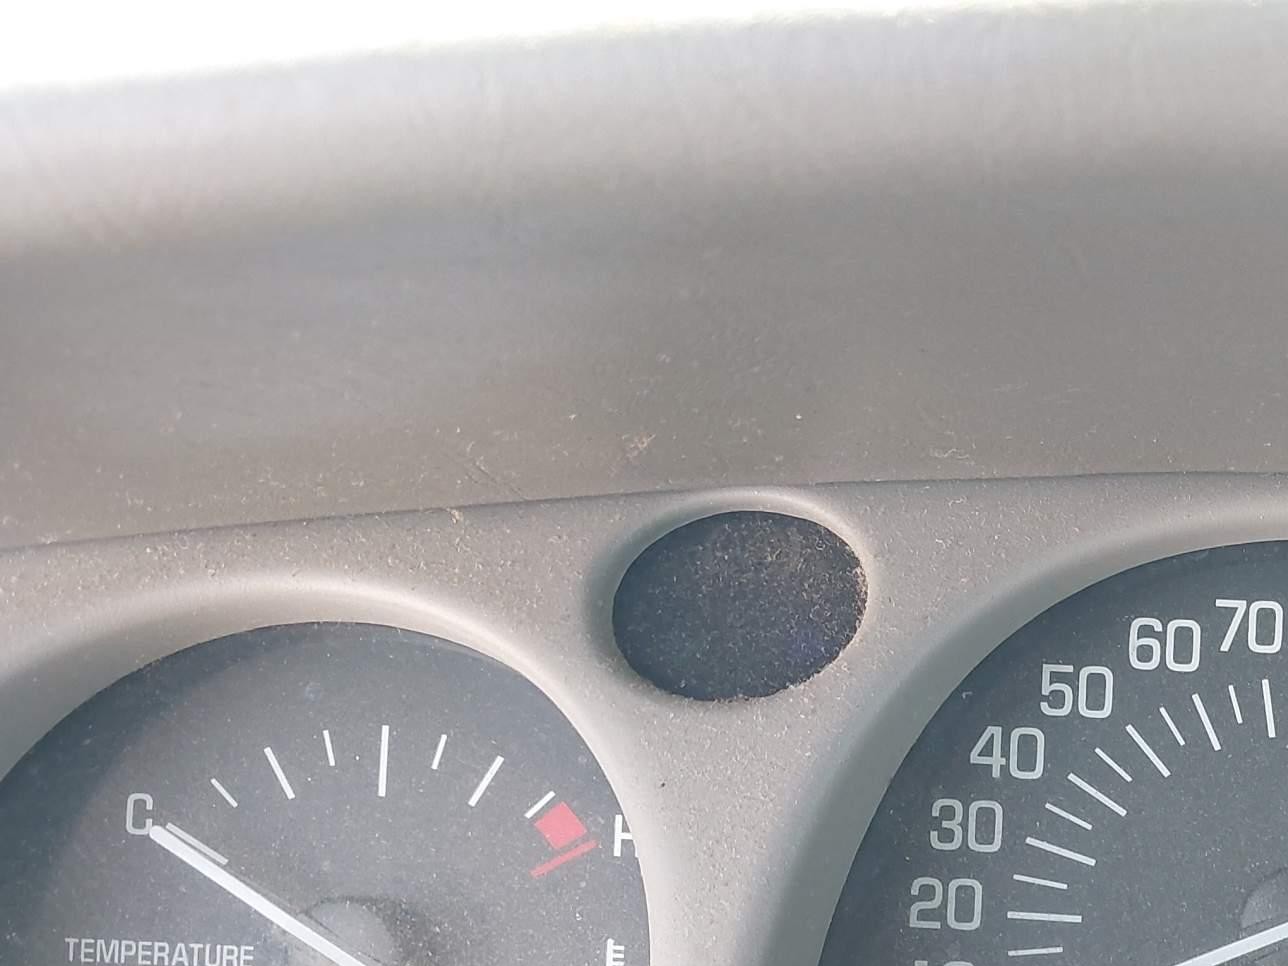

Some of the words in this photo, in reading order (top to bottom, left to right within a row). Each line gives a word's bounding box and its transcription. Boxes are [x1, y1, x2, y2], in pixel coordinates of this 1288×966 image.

[1128, 617, 1202, 673] 60
[1215, 599, 1285, 654] 70
[1039, 664, 1114, 719] 50
[969, 726, 1045, 780] 40
[125, 793, 154, 836] C
[930, 799, 1003, 853] 30
[909, 877, 983, 931] 20
